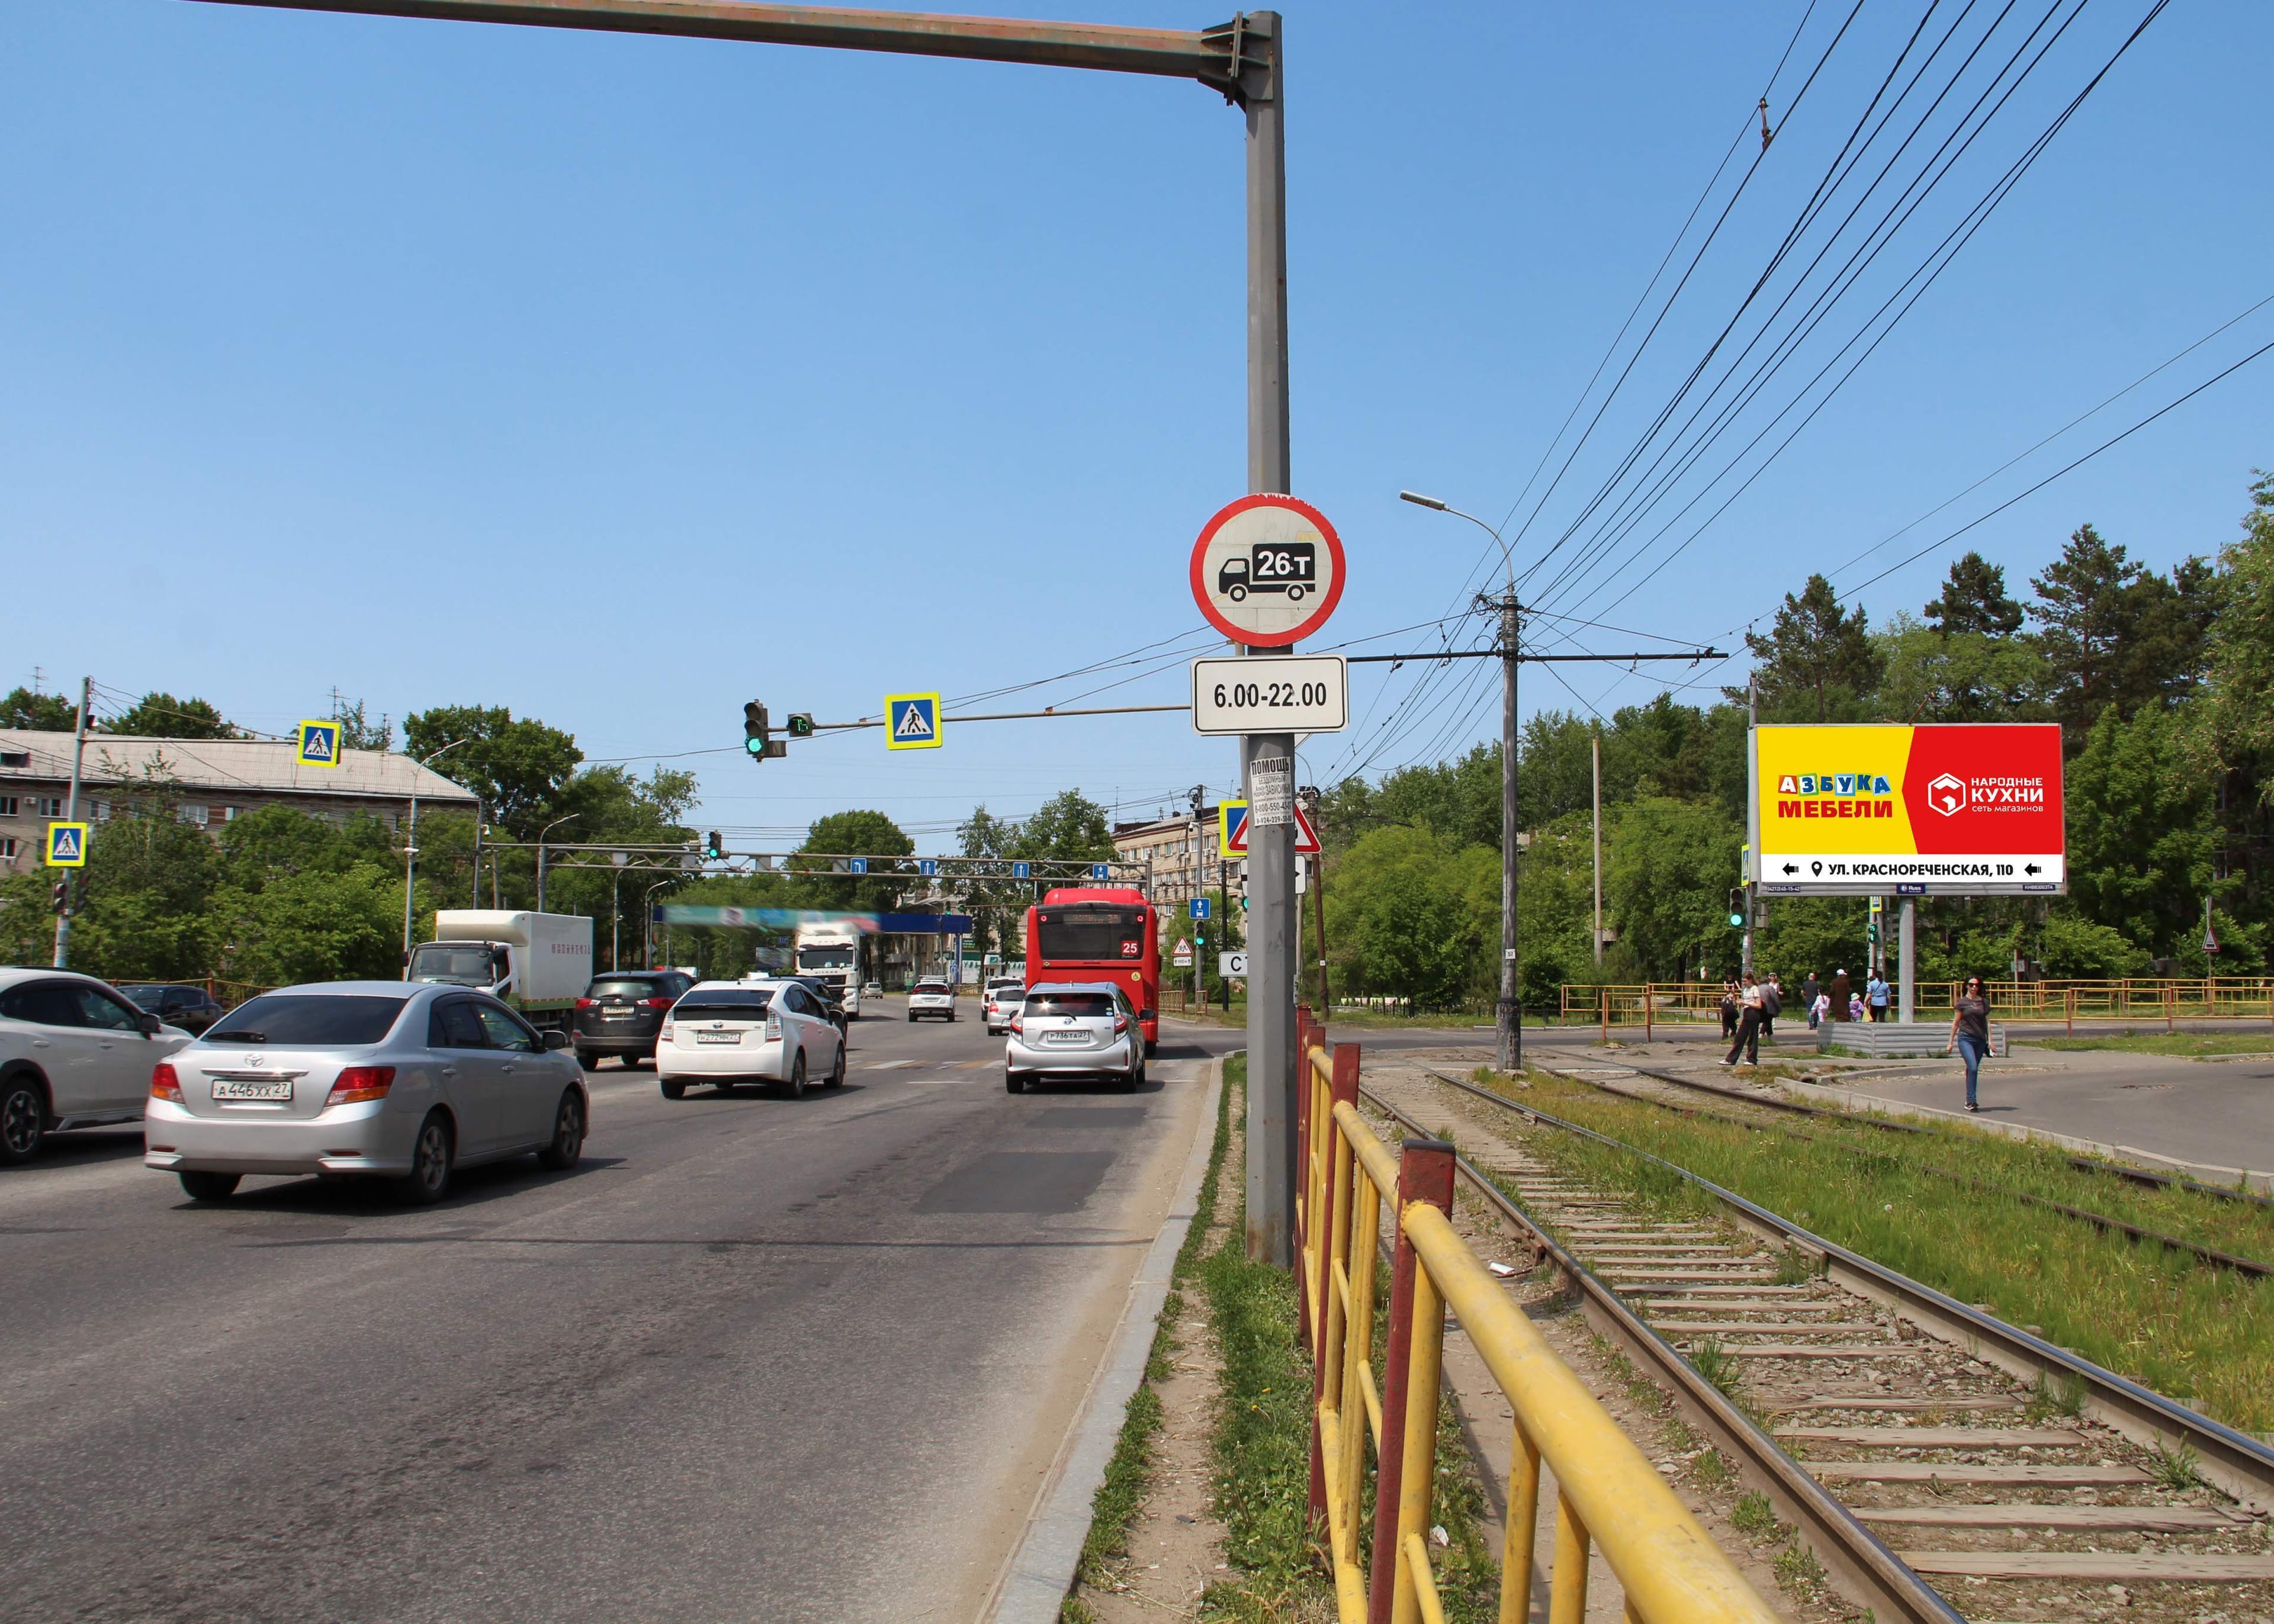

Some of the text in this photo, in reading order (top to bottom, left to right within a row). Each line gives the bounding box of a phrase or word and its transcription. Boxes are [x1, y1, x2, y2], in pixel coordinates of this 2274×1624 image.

[1214, 683, 1326, 708] 6.00-22.00
[1251, 758, 1289, 776] ПОМОЩЬ
[1779, 774, 1891, 795] АЗБУКА
[1971, 777, 2043, 787] НАРОДНЫЕ
[1971, 788, 2044, 802] КУХНИ
[1778, 801, 1893, 818] МЕБЕЛИ
[1994, 805, 2043, 813] магазинов
[1829, 864, 2013, 877] УЛ. КРАСНОРЕЧЕНСКАЯ, 110
[1123, 943, 1138, 953] 25
[219, 1083, 288, 1097] А446ХХ 27
